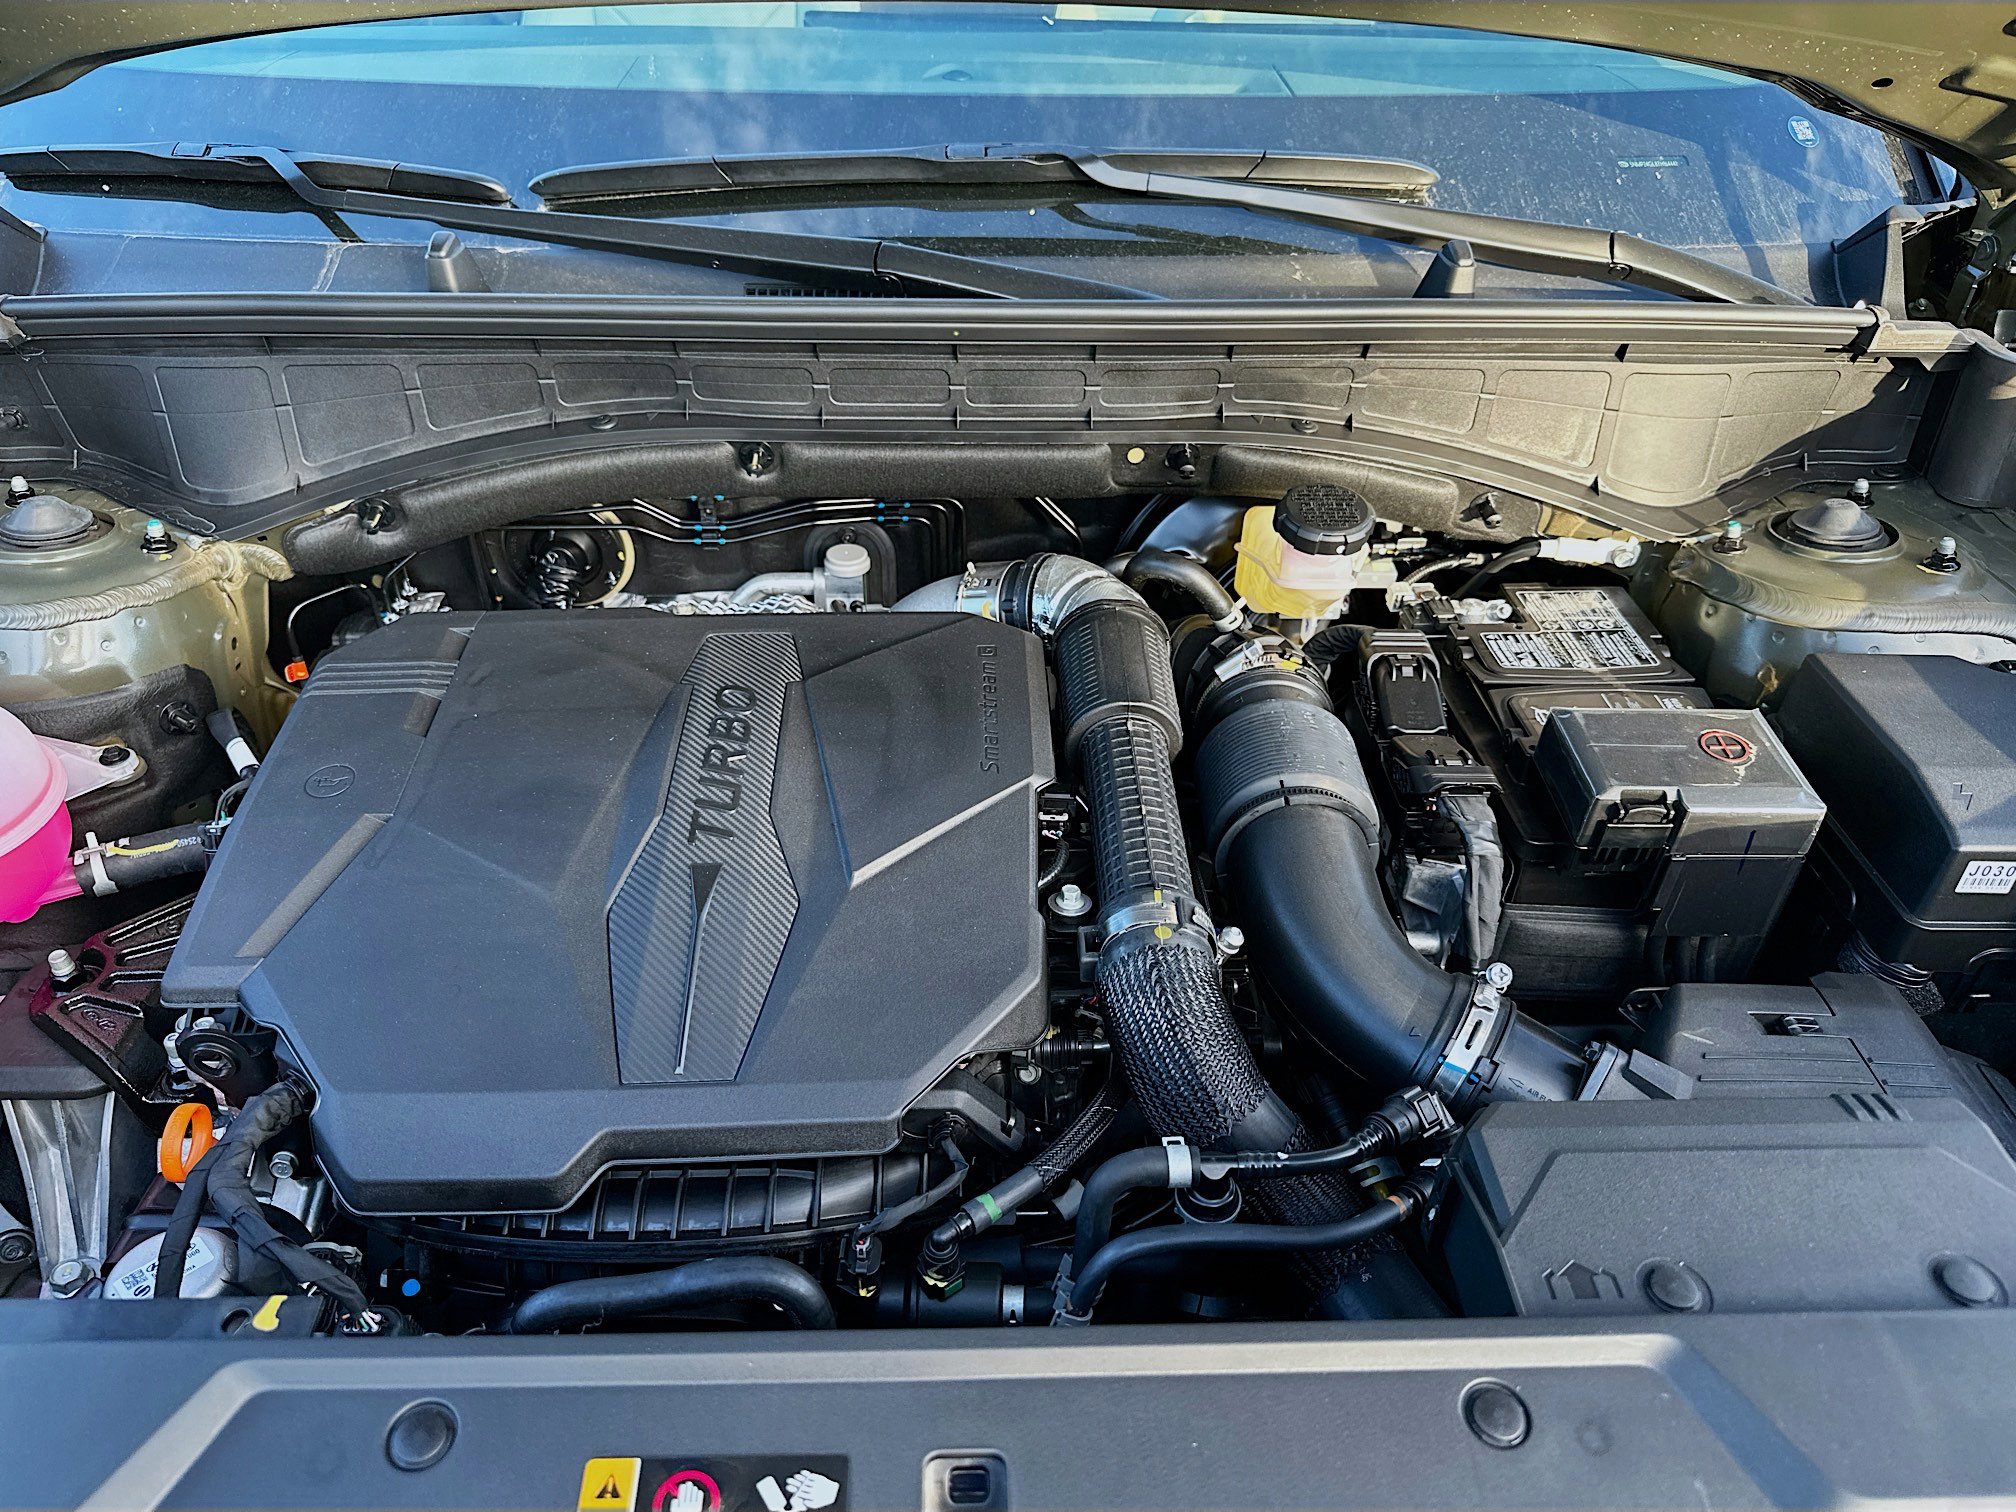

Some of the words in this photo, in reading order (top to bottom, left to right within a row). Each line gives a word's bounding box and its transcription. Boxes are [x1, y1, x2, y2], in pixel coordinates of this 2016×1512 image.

[979, 660, 1000, 774] Smartstream
[687, 684, 758, 845] TURBO
[1968, 865, 2016, 877] J030
[1527, 1087, 1540, 1098] AIR
